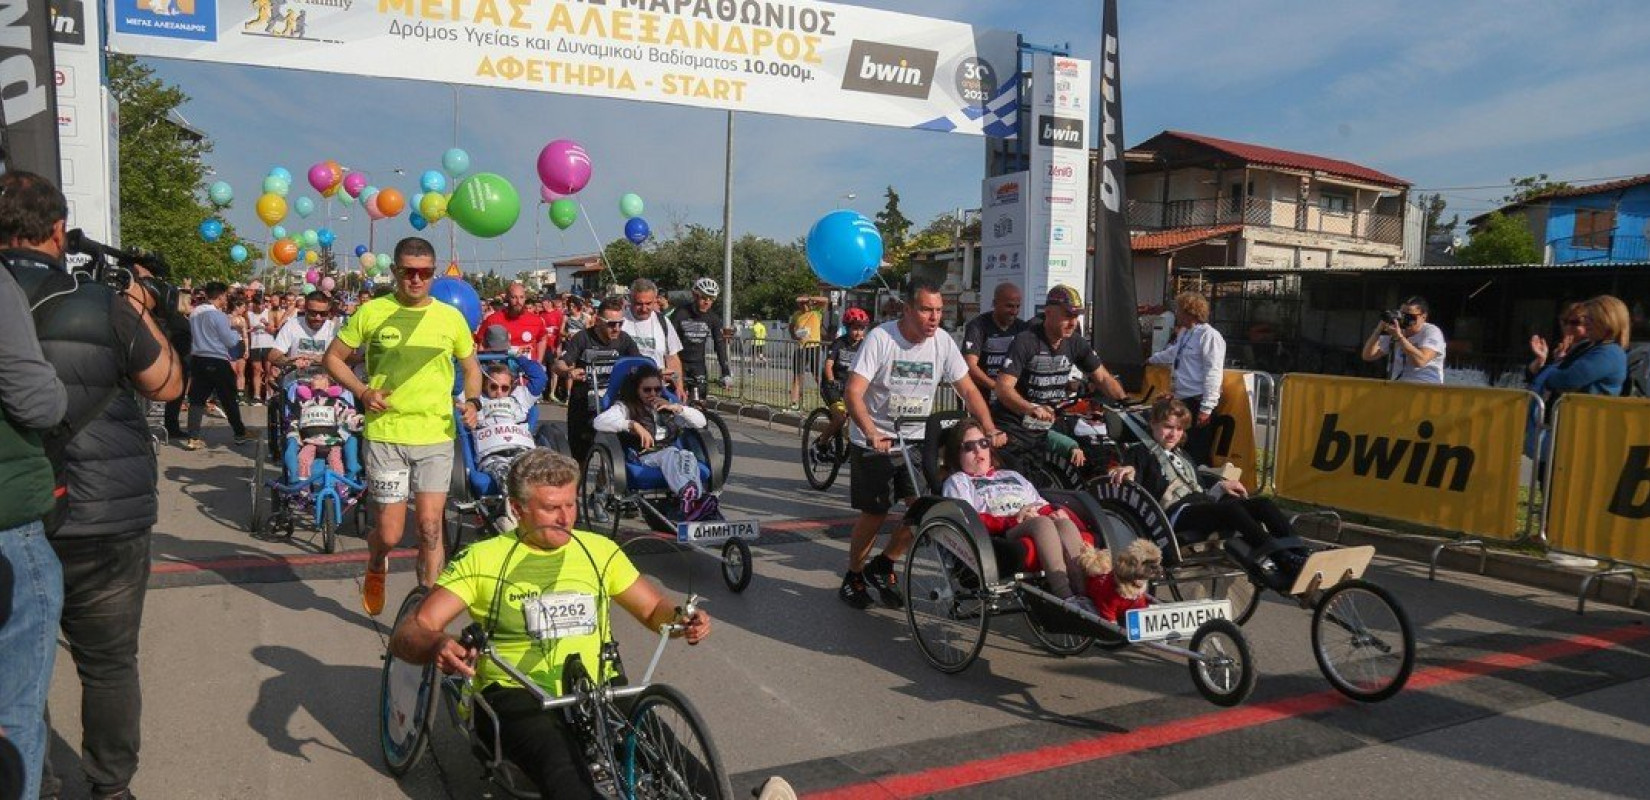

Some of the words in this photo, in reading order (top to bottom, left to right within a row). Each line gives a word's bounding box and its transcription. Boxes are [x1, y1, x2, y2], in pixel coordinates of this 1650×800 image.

[389, 19, 458, 42] Δρόμος
[464, 26, 519, 47] Υγείας
[525, 36, 550, 51] και
[556, 36, 643, 61] Δυναμικού
[649, 47, 738, 71] Βαδίσματος
[744, 59, 815, 83] 10.000μ.
[546, 2, 822, 64] ΑΛΕΞΑΝΔΡΟΣ
[475, 54, 637, 91] ΑΦΕΤΗΡΙΑ
[662, 73, 747, 101] START
[1311, 412, 1476, 492] bwin
[693, 523, 754, 538] ΔΗΜΗΤΡΑ
[509, 588, 538, 602] bwin
[1144, 607, 1226, 633] ΜΑΡΙΛΕΝΑ
